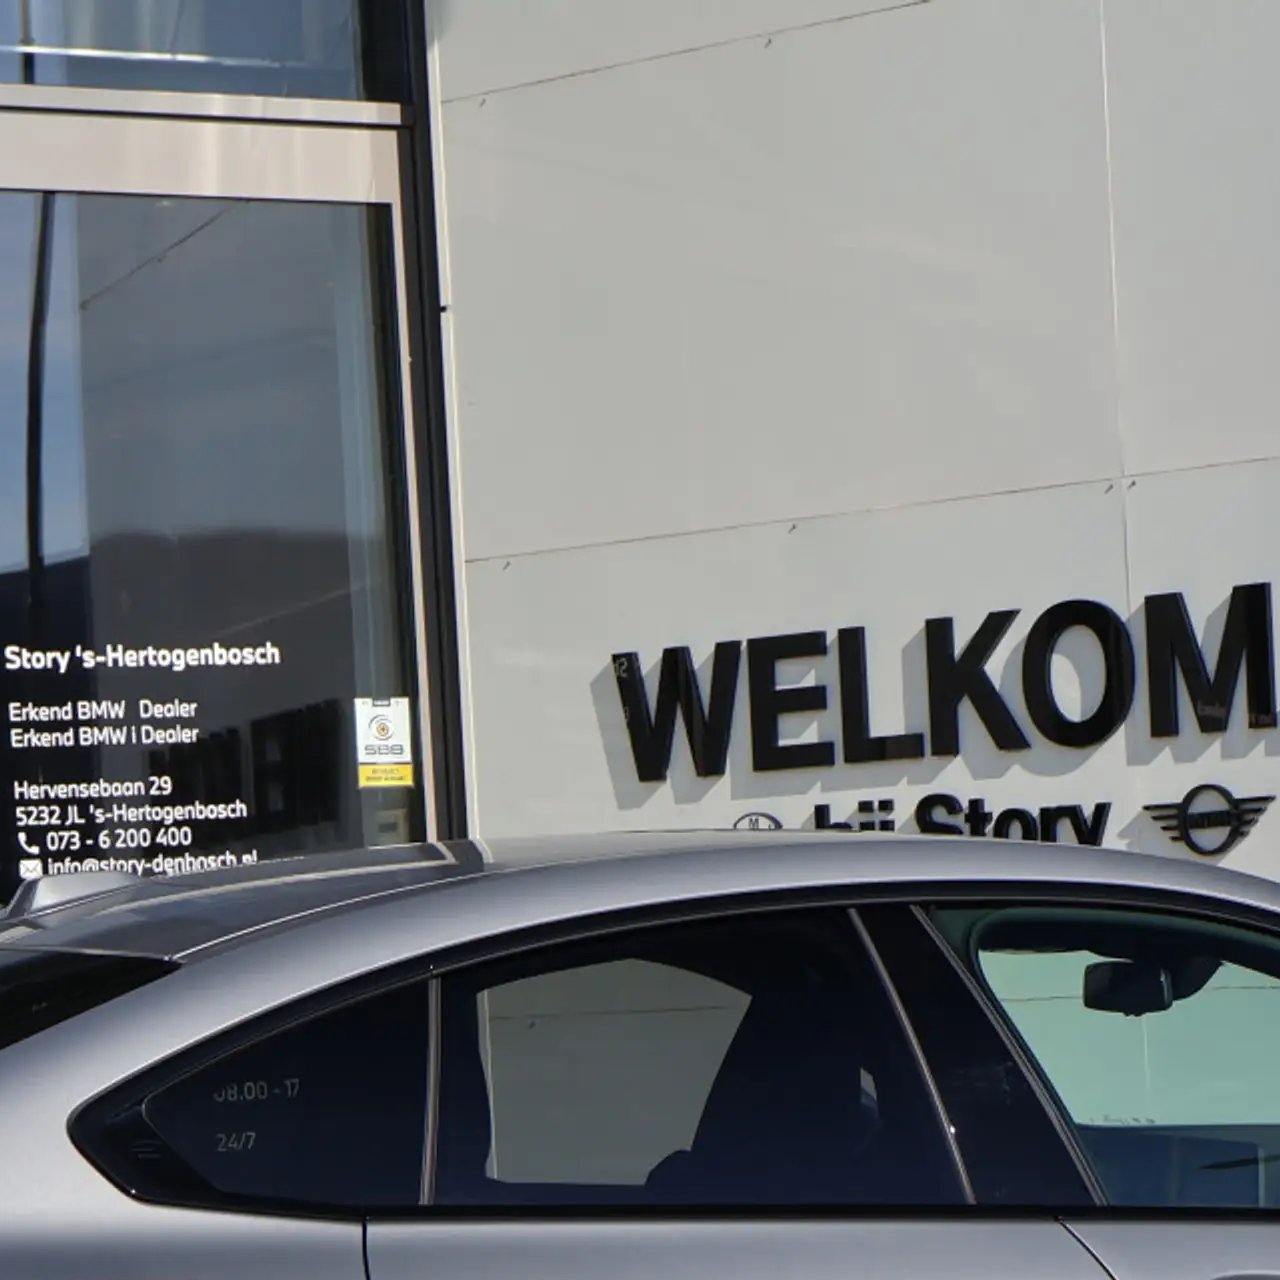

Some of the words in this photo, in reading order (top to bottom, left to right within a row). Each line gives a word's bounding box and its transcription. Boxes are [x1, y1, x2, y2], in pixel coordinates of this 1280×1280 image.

[4, 644, 70, 673] Story
[75, 642, 281, 671] 's-Hertogenbosch
[8, 702, 73, 721] Erkend
[77, 700, 125, 719] BMW
[139, 698, 198, 719] Dealer
[10, 727, 75, 747] Erkend
[79, 725, 127, 745] BMW
[141, 724, 200, 744] Dealer
[14, 778, 145, 800] Hervensebaan
[148, 776, 173, 795] 29
[16, 806, 61, 826] 5232
[65, 805, 86, 826] JL
[89, 799, 248, 825] 's-Hertogenbosch
[46, 831, 81, 851] 073
[98, 829, 110, 849] 6
[115, 828, 151, 848] 200
[156, 826, 192, 846] 400
[216, 1132, 256, 1152] 24/7
